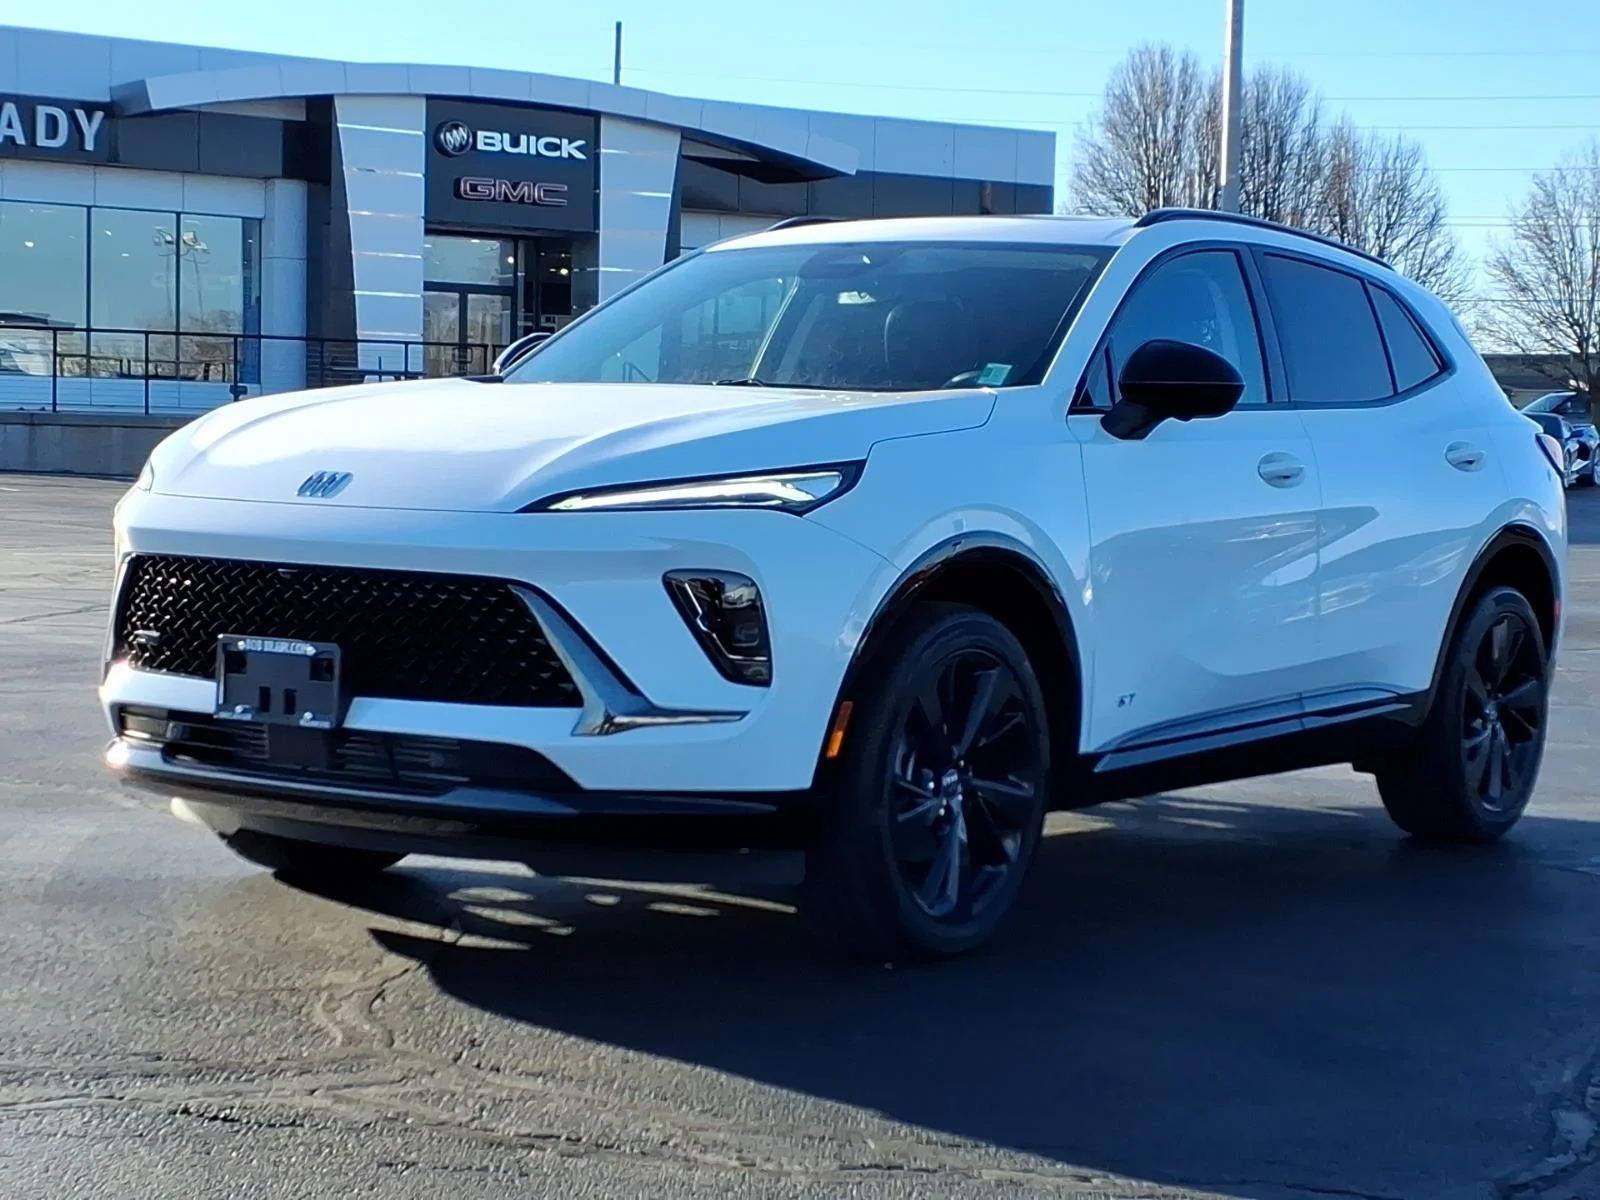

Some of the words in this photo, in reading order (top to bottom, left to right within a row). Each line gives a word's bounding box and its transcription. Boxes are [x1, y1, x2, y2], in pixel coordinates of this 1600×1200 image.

[0, 101, 105, 151] ADY
[476, 130, 587, 160] BUICK
[459, 176, 568, 206] GMC
